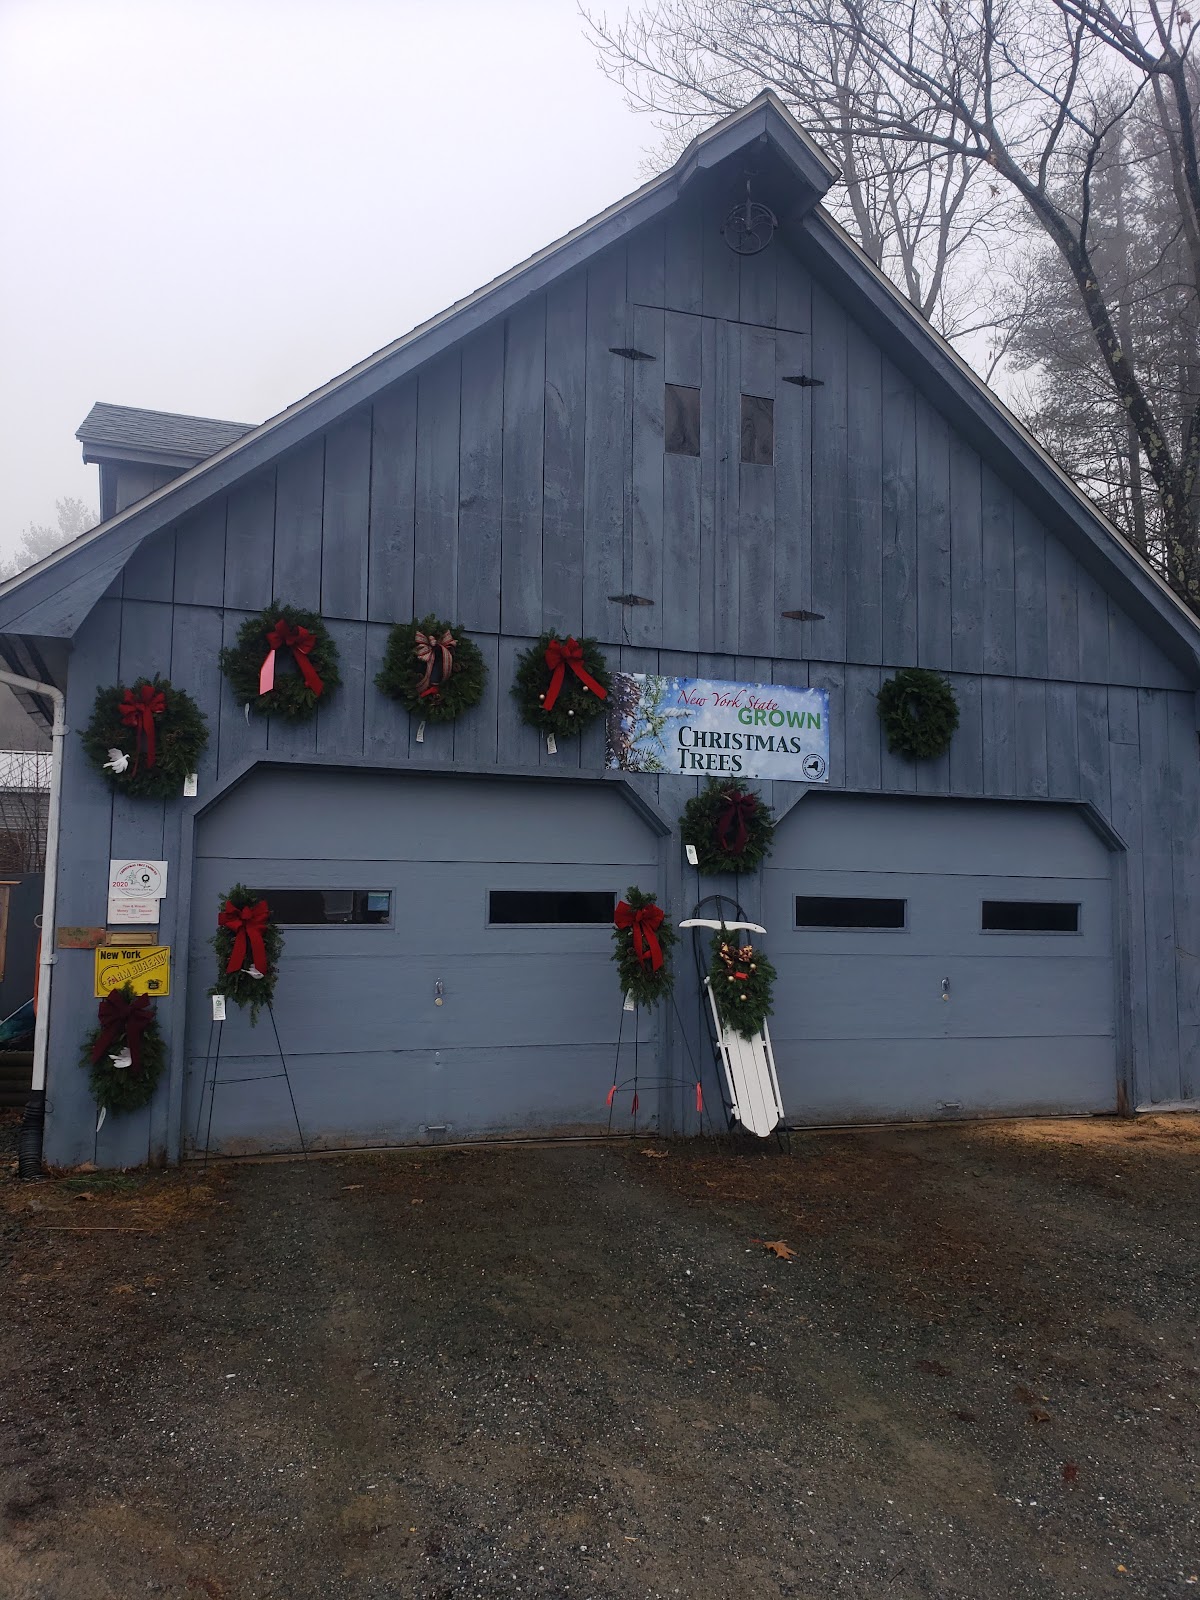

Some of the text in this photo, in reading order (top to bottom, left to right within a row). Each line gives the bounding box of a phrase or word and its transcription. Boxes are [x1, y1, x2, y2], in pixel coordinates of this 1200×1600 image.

[677, 688, 780, 711] New York State
[738, 707, 821, 730] GROWN
[678, 725, 801, 754] CHRISTMAS
[677, 747, 743, 772] TREES
[100, 950, 141, 960] New York
[106, 953, 166, 987] FARM BUREAU
